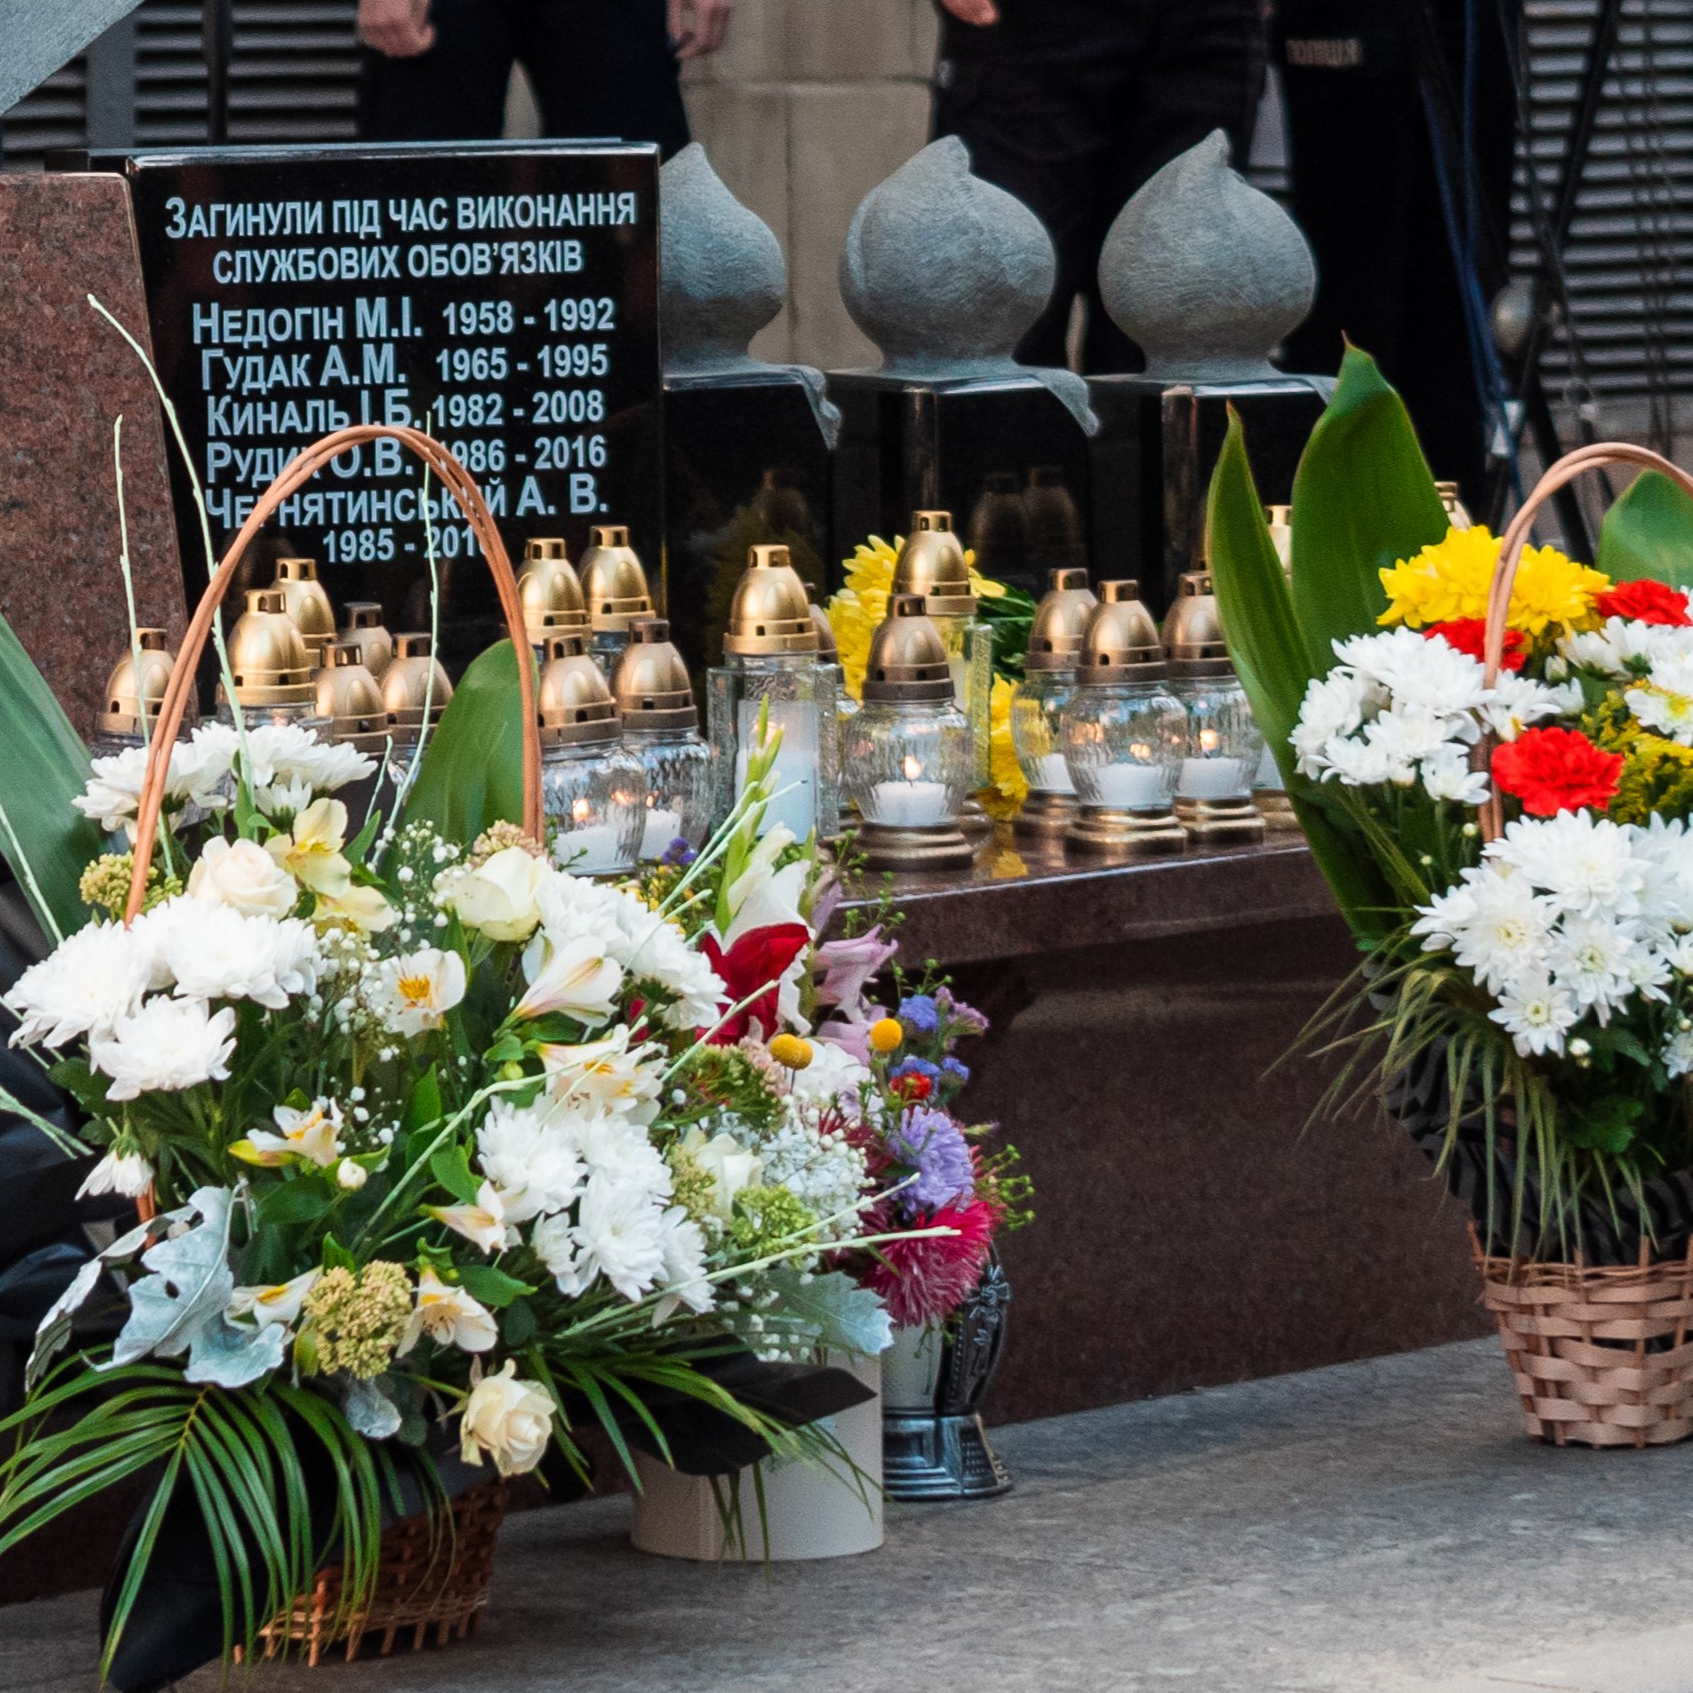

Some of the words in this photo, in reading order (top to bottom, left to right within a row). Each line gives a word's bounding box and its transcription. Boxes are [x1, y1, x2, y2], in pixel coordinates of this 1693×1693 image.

[164, 196, 324, 239] ЗАГИНУЛИ
[332, 199, 382, 240] ПІД
[388, 197, 448, 232] ЧАС
[456, 191, 636, 231] ВИКОНАННЯ
[212, 244, 401, 285] СЛУЖБОВИХ
[192, 302, 345, 350] НЕДОГІН
[442, 300, 515, 336] 1958
[543, 297, 616, 332] 1992
[201, 348, 312, 396] ГУДАК
[435, 346, 508, 382] 1965
[537, 343, 609, 378] 1995
[207, 394, 351, 437] КИНАЛЬ
[431, 392, 504, 428] 1982
[532, 389, 605, 425] 2008
[440, 438, 506, 473] 986
[534, 434, 607, 470] 2016
[204, 476, 507, 530] ЧЕНЯТИНСЬКЙ
[515, 475, 557, 517] А.
[569, 472, 609, 514] В.
[322, 527, 395, 563] 1985
[423, 524, 488, 559] 201
